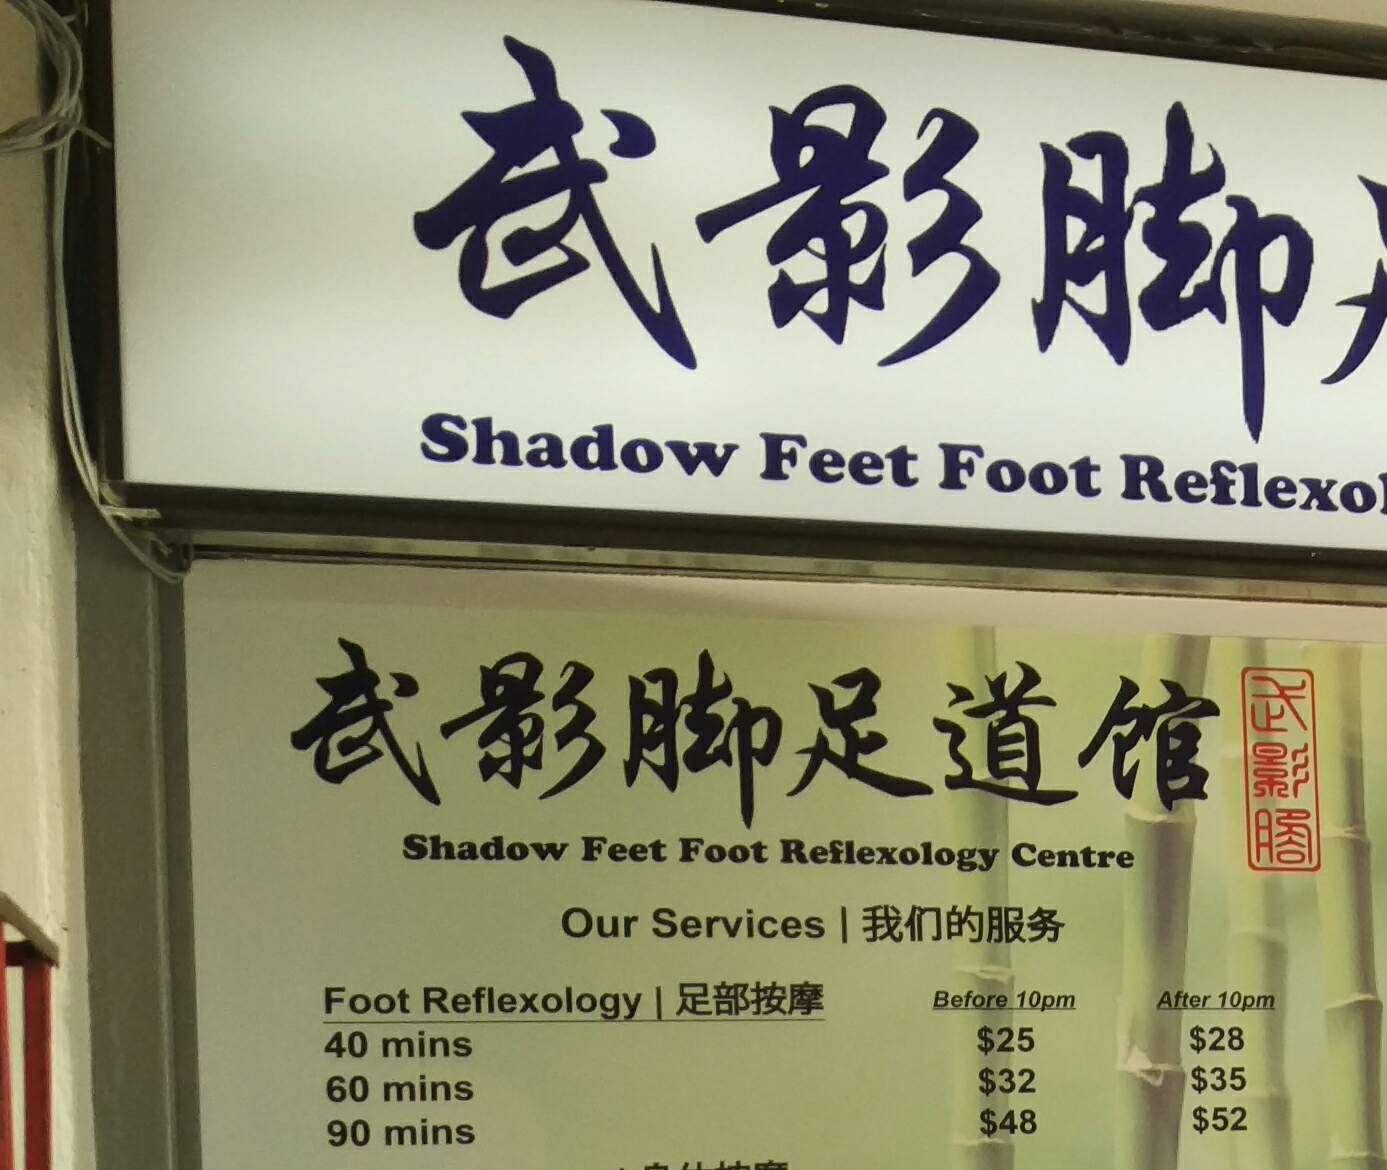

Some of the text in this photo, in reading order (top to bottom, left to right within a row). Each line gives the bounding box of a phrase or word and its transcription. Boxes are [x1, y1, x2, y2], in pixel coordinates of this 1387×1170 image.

[421, 413, 739, 477] Shadow
[760, 433, 918, 487] Feet
[939, 443, 1101, 497] Foot
[291, 637, 1220, 832] 武影脚足道馆
[403, 834, 1134, 872] Shadow Feet Foot Reflexology Centre
[562, 905, 1065, 943] Our Services 我们的服务
[325, 981, 824, 1021] Foot Reflexology 足部按摩
[933, 990, 1076, 1011] Before 10pm
[1157, 991, 1275, 1011] After 10pm
[325, 1031, 472, 1058] 40 mins
[978, 1025, 1034, 1056] $25
[1190, 1025, 1244, 1054] $28
[327, 1075, 473, 1102] 60 mins
[979, 1067, 1036, 1096] $32
[1192, 1066, 1246, 1094] $35
[328, 1119, 475, 1147] 90 mins
[980, 1108, 1037, 1138] $48
[1193, 1106, 1247, 1134] $52
